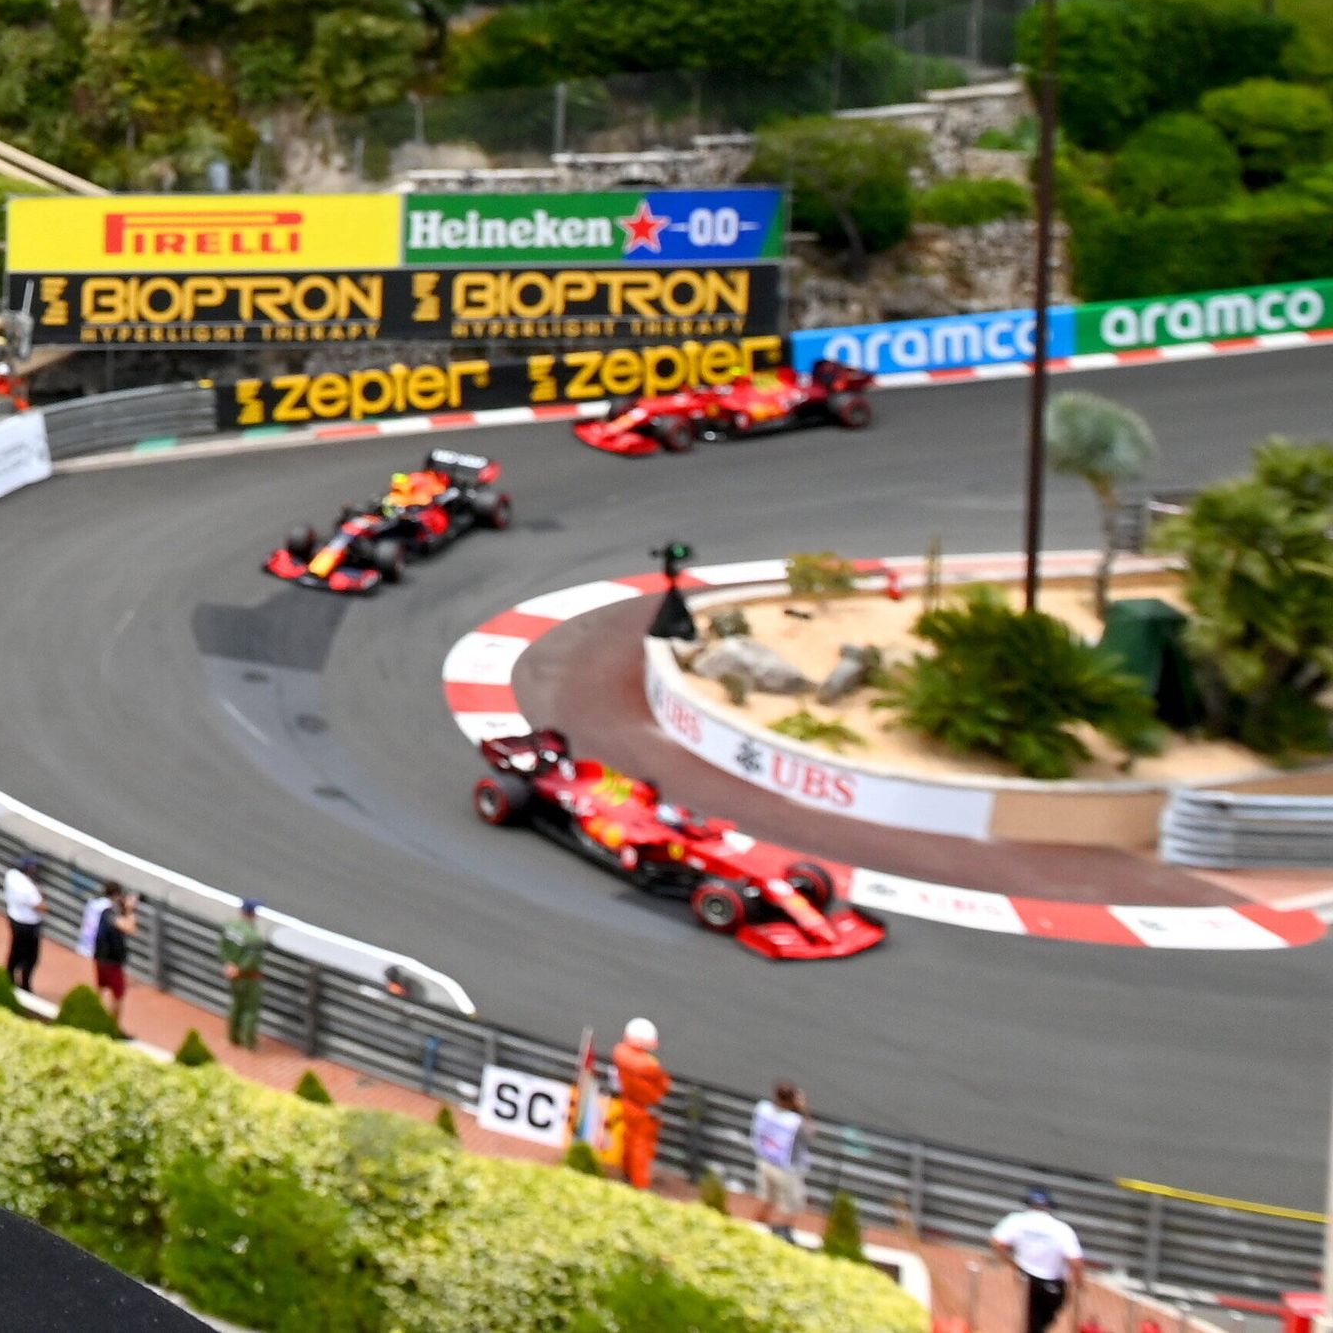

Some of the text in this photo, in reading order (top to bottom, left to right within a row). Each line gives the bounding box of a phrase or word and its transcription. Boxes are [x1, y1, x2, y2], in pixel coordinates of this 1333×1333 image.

[103, 210, 303, 254] PIRELLI
[408, 210, 613, 249] Heineken
[80, 274, 383, 323] BIOPTRON
[451, 269, 750, 319] BIOPTRON
[1100, 288, 1325, 347] aramco
[80, 321, 381, 343] HYPERLIGHT THERAPY
[451, 317, 746, 339] HYPERLIGHT THERAPY
[272, 359, 490, 421] zepter
[564, 334, 782, 400] zepter
[772, 753, 858, 808] UBS
[494, 1082, 555, 1129] SC
